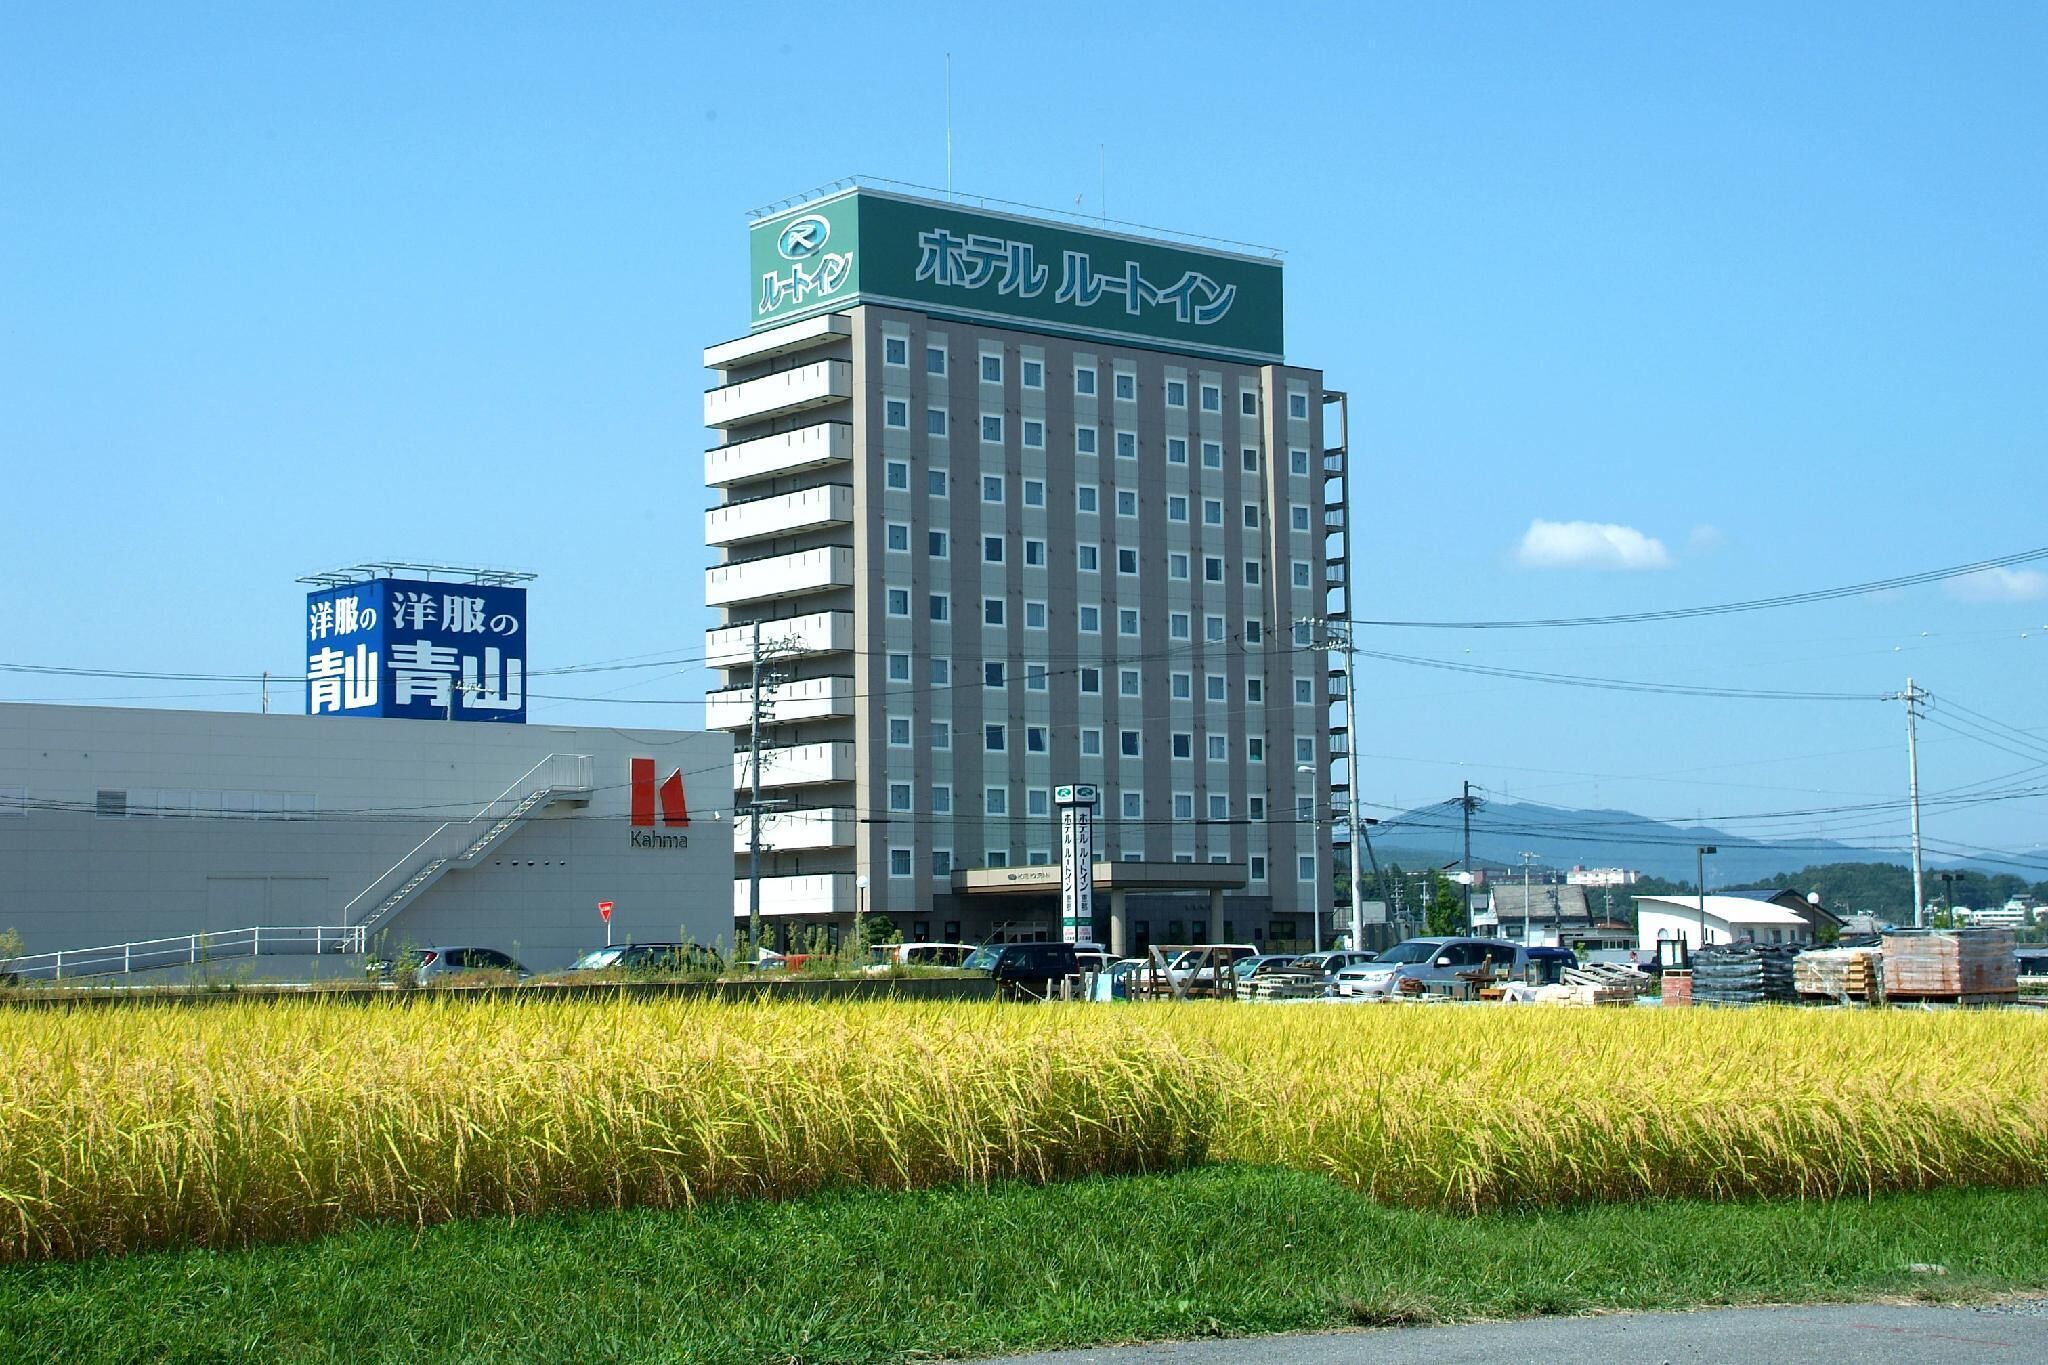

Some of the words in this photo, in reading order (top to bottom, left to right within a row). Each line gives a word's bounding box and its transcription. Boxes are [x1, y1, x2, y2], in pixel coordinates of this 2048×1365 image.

[759, 252, 853, 314] ルートイン
[915, 228, 1049, 298] ホテル
[1055, 250, 1237, 325] ルートイン
[309, 596, 377, 641] 洋服の
[392, 591, 519, 636] 洋服の
[307, 643, 378, 715] 青山
[387, 639, 522, 710] 青山
[630, 830, 688, 848] Kahma
[1064, 847, 1072, 892] ルートイン
[1079, 847, 1089, 892] ルートイン
